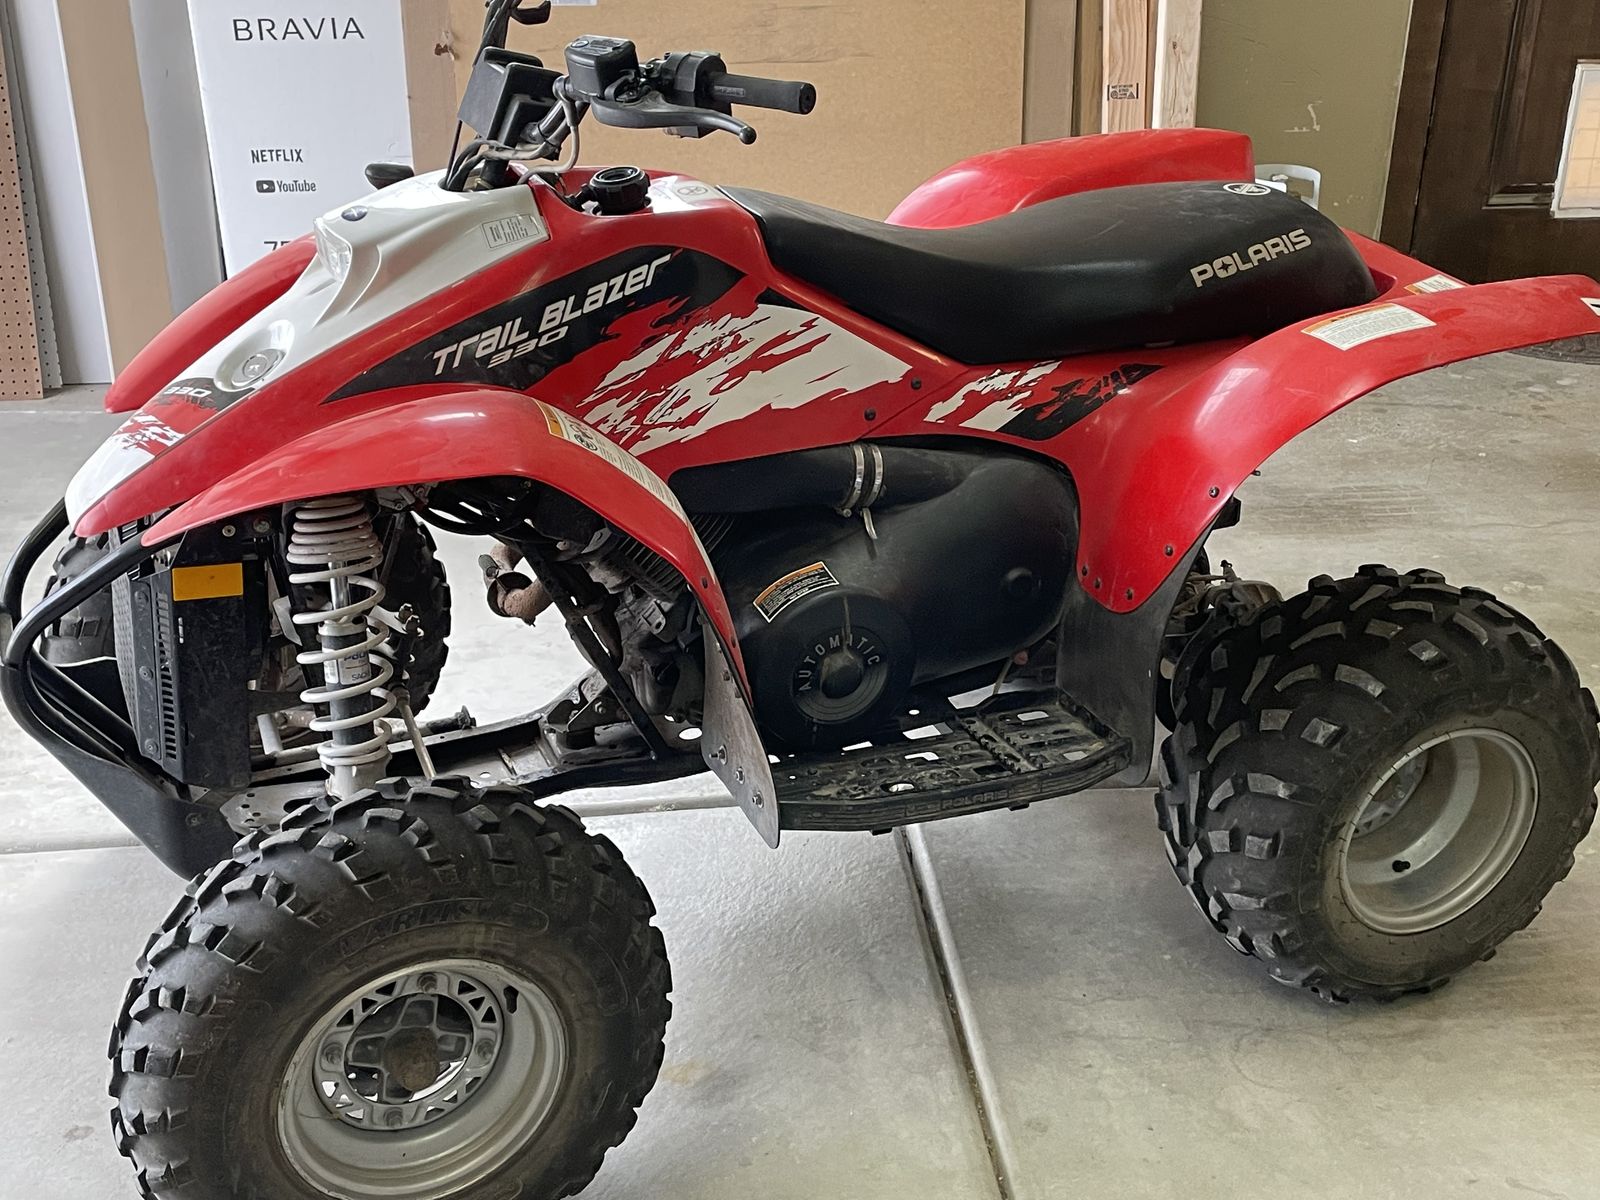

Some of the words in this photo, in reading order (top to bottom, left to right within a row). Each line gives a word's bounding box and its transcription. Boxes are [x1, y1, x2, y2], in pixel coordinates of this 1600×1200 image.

[232, 16, 365, 41] BRAVIA
[250, 148, 304, 164] NETFLIX
[276, 179, 317, 193] YouTube
[1189, 228, 1312, 288] POLARIS
[487, 325, 569, 369] 330
[797, 632, 882, 693] AUTOMATIC
